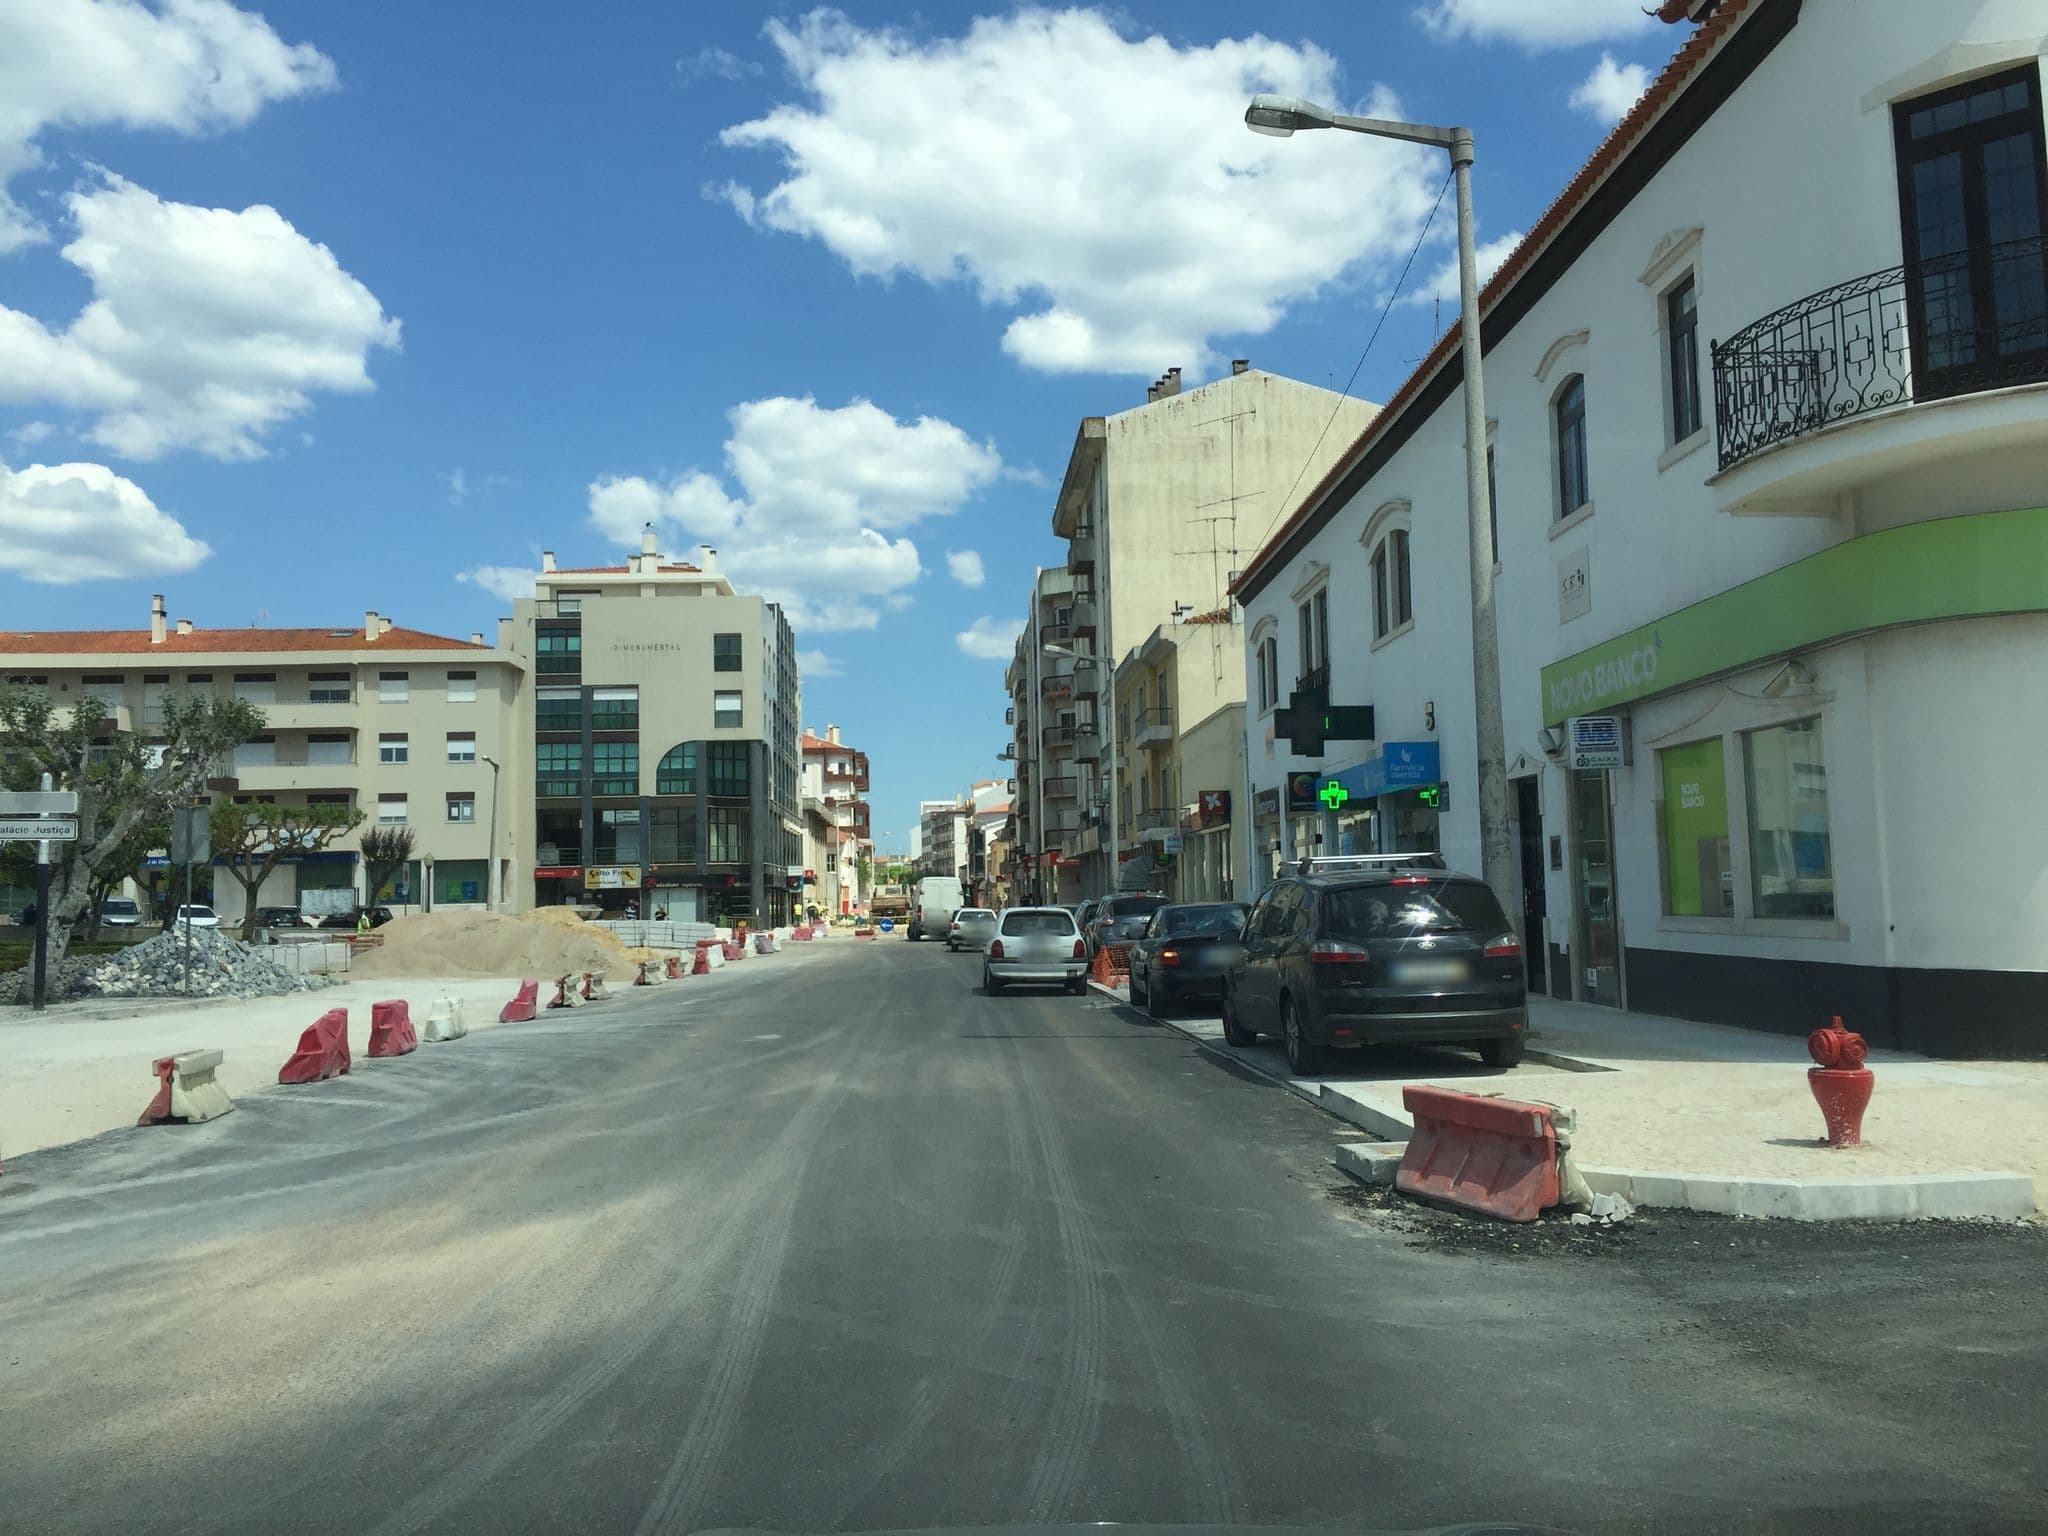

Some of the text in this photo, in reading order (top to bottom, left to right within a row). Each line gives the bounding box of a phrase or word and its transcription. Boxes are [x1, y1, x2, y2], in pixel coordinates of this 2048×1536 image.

[1550, 644, 1657, 714] NOVO BANCO
[1680, 782, 1700, 795] NOVO
[1681, 794, 1705, 808] BANCO
[0, 825, 70, 834] alácio Justiça
